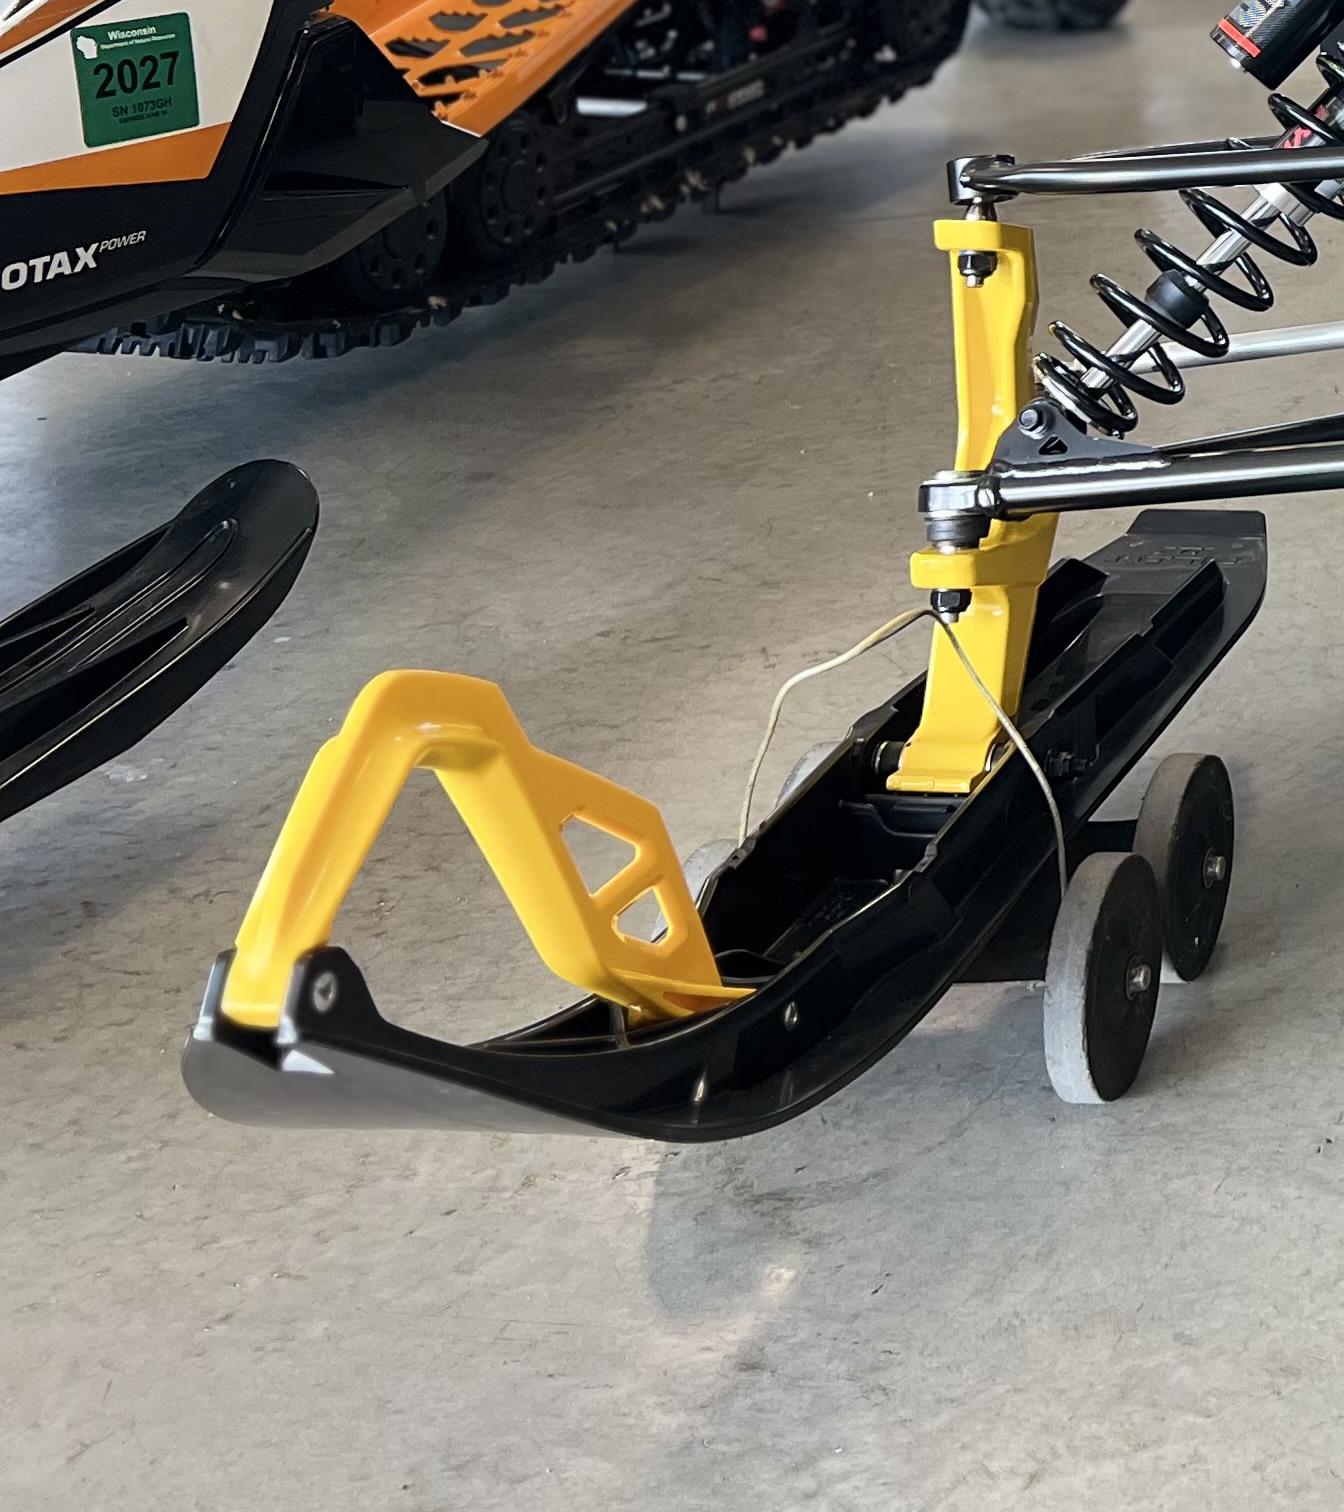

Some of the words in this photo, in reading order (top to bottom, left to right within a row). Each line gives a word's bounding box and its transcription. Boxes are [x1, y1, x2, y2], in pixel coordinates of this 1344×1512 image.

[107, 25, 157, 41] Wisconsin
[93, 50, 179, 99] 2027
[112, 105, 129, 118] SN
[1, 242, 100, 291] OTAX
[99, 230, 147, 253] POWER
